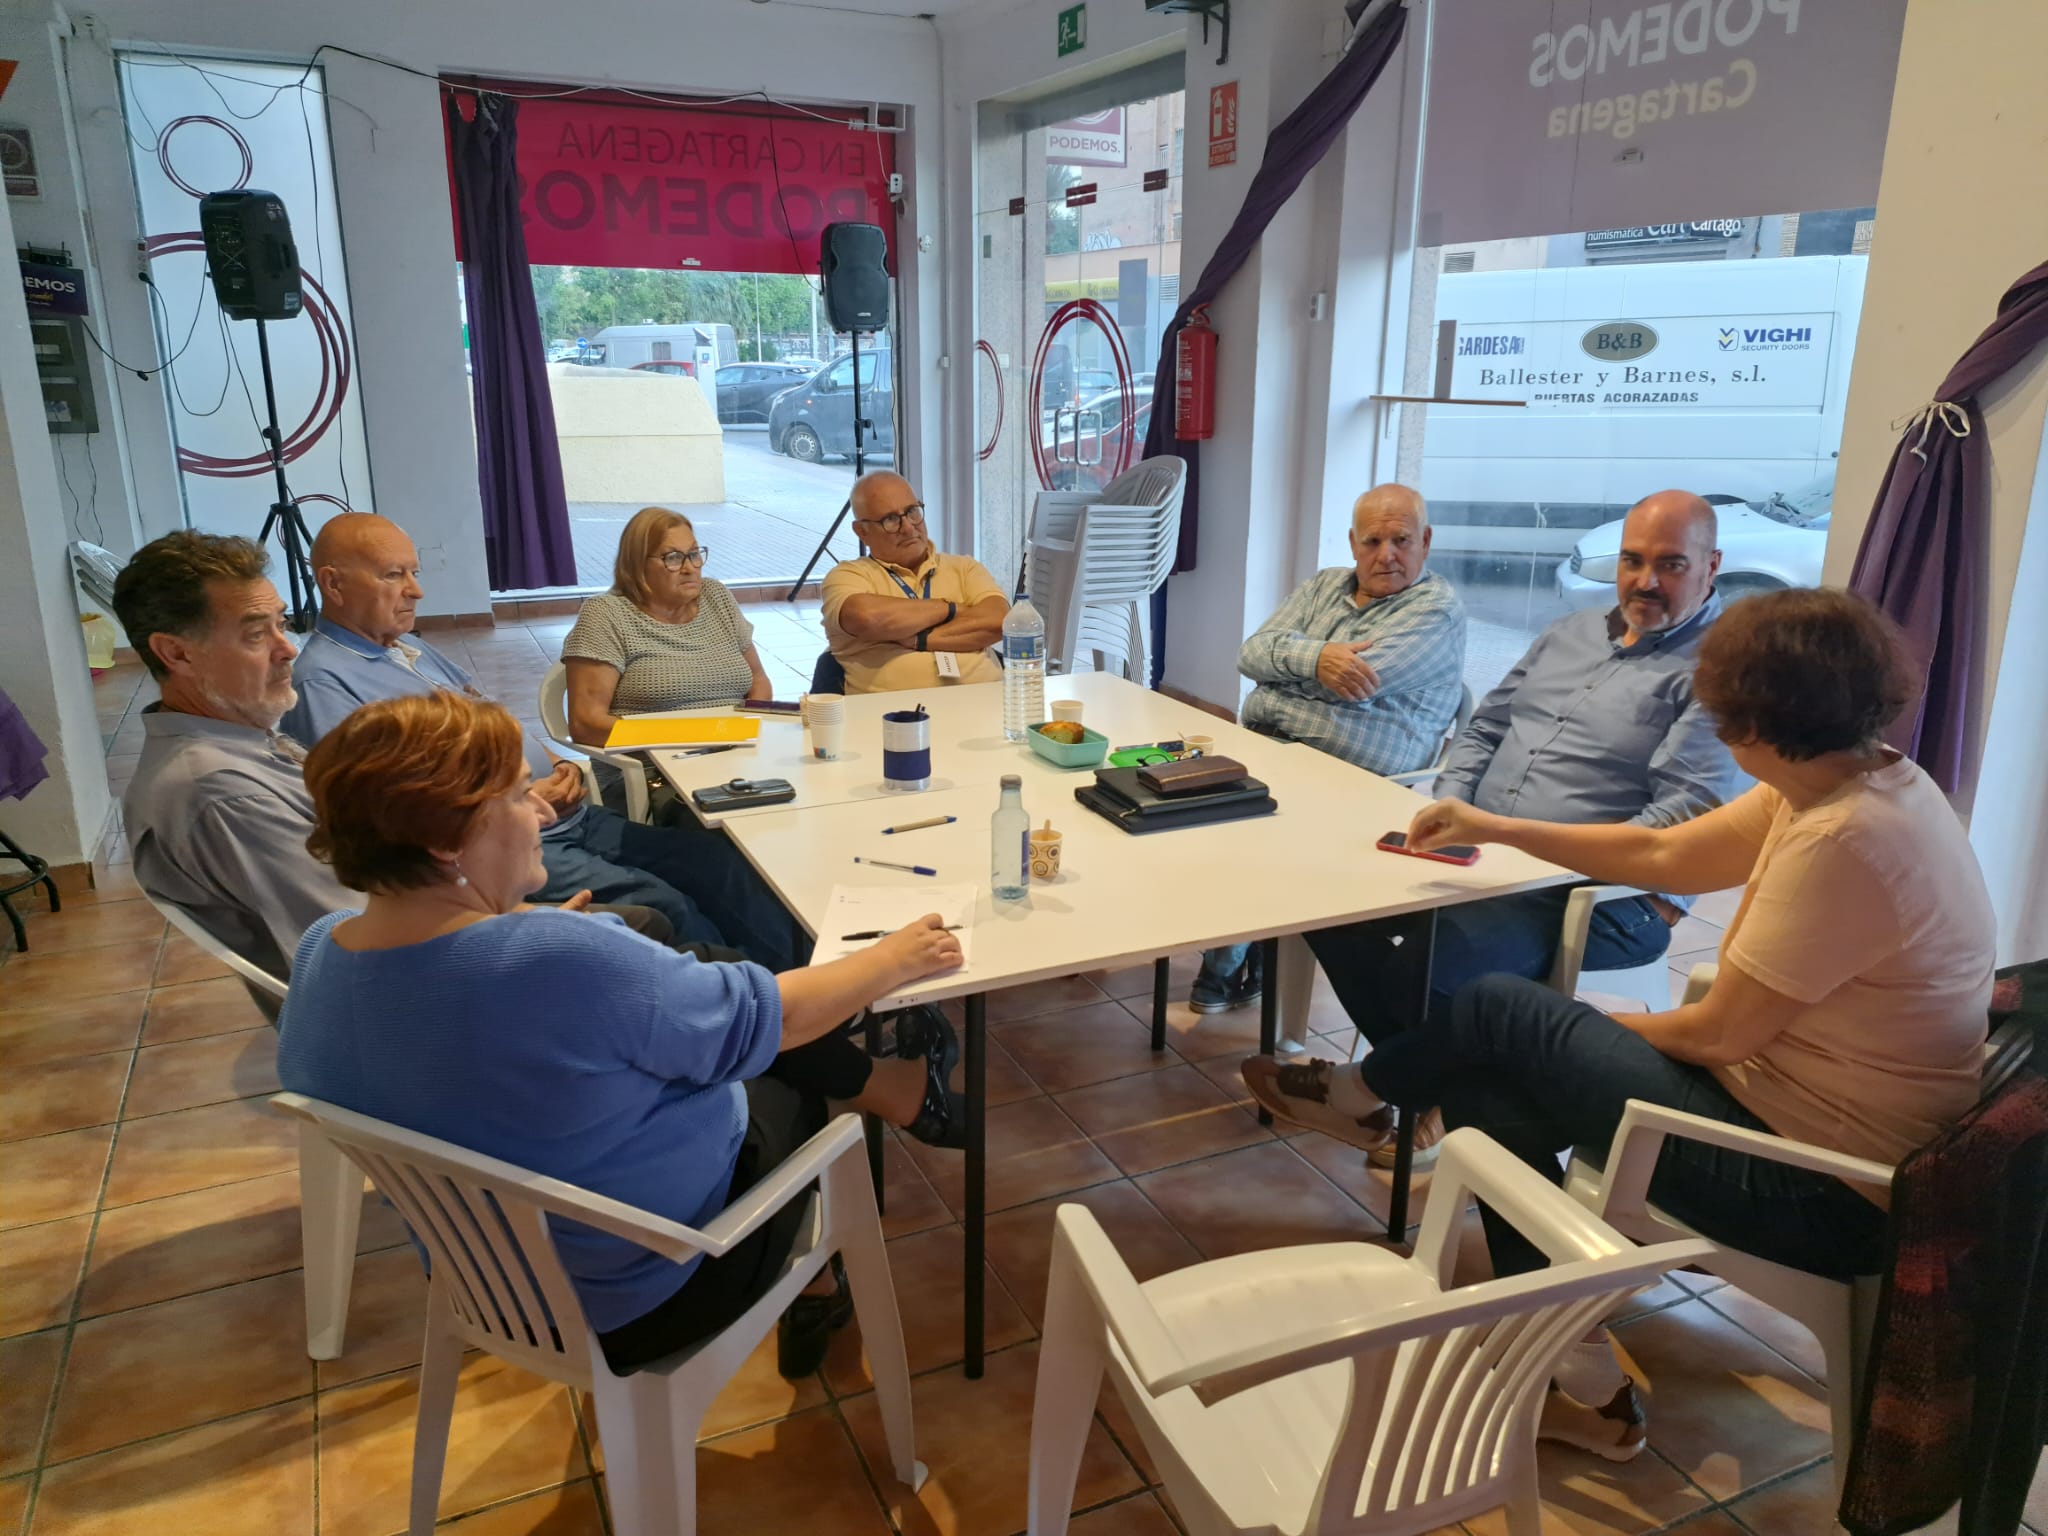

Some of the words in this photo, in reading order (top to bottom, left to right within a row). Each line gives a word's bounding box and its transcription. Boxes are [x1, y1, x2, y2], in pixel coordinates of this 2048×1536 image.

[24, 276, 77, 293] EMOS
[1596, 332, 1643, 351] B&B
[1743, 327, 1812, 343] VIGHI
[1741, 344, 1780, 352] SECURITY
[1781, 343, 1810, 351] DOORS
[1480, 367, 1584, 386] Ballester
[1595, 371, 1609, 387] y
[1623, 365, 1717, 386] Barnes,
[1731, 364, 1767, 383] s.l.
[1534, 393, 1596, 403] PUERTAS
[1603, 392, 1699, 403] ACORAZADAS
